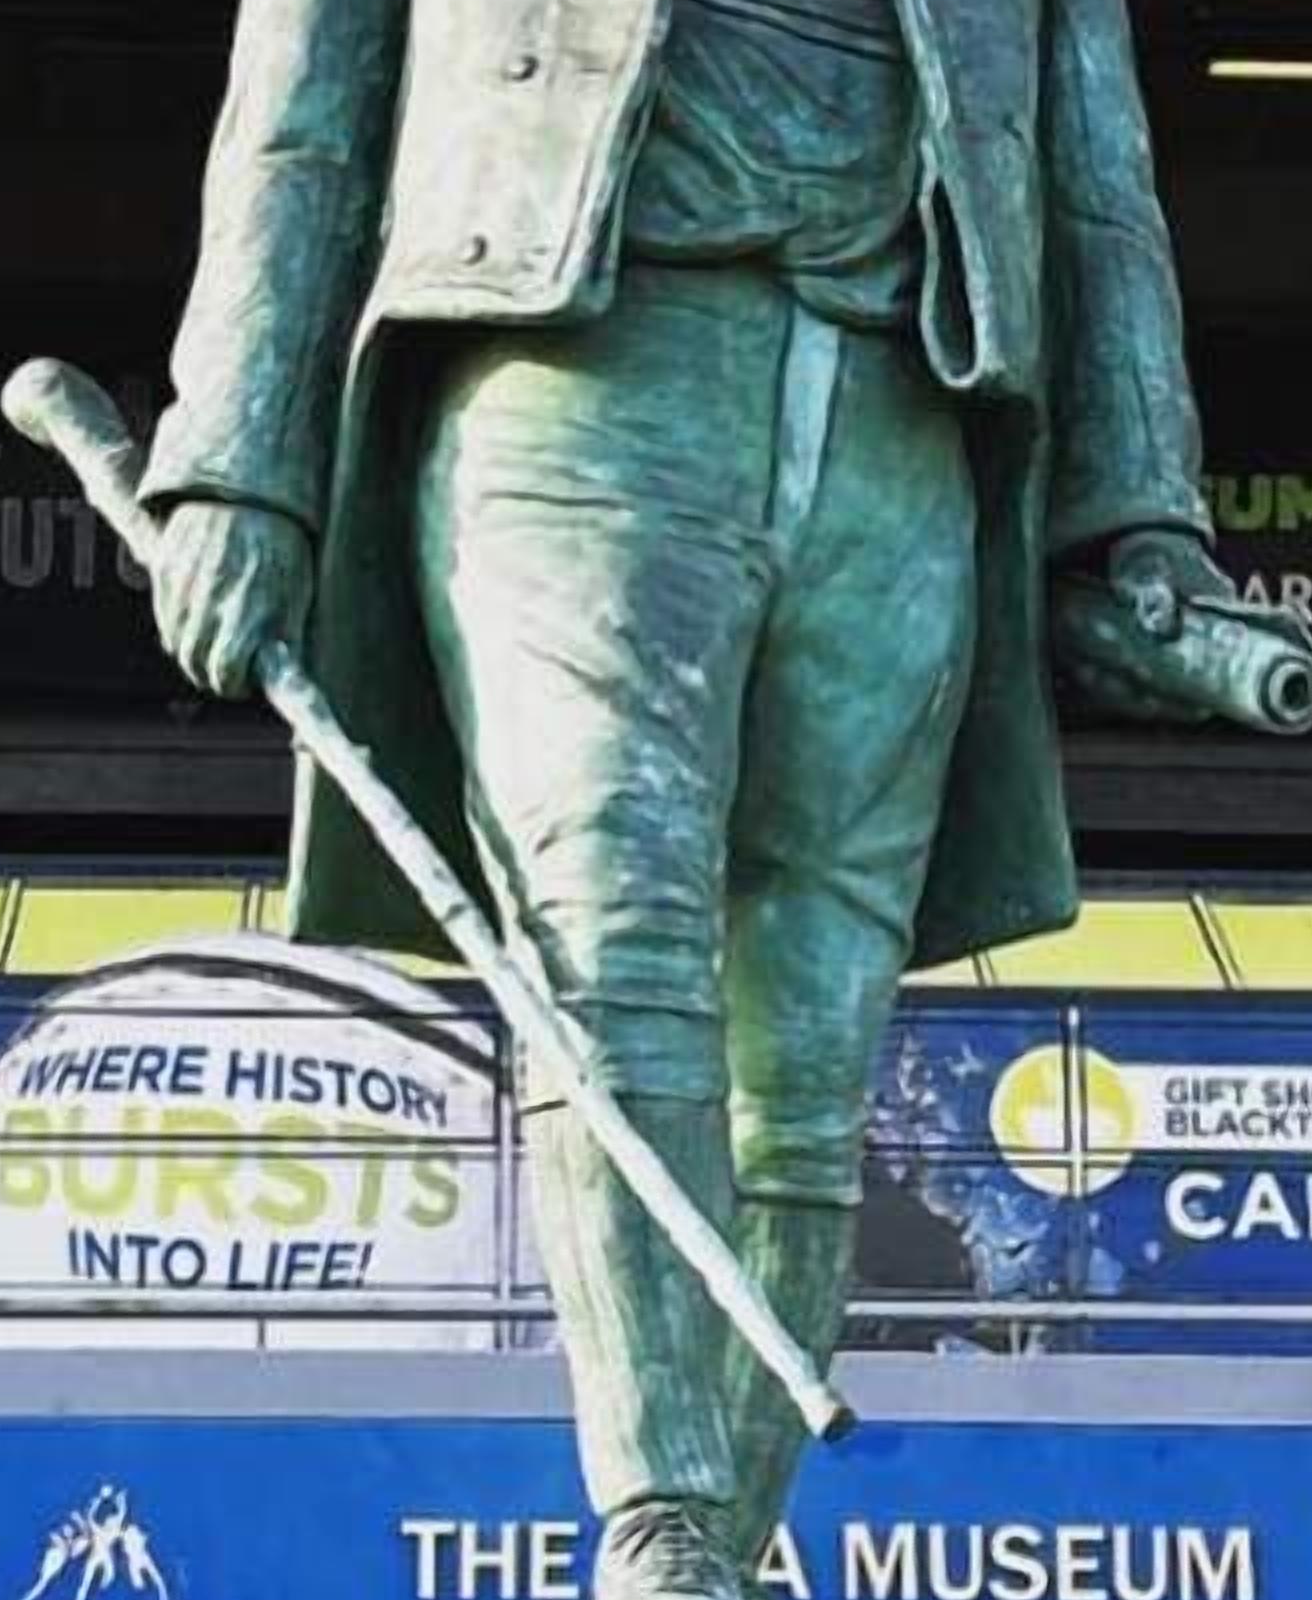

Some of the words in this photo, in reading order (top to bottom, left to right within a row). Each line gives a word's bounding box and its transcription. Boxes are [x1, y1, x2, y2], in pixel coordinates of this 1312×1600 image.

[19, 1045, 208, 1098] WHERE
[225, 1048, 450, 1129] HISTORY
[1164, 1077, 1247, 1106] GIFT
[67, 1228, 207, 1290] INTO
[226, 1237, 376, 1292] LIFE!
[401, 1518, 582, 1600] THE
